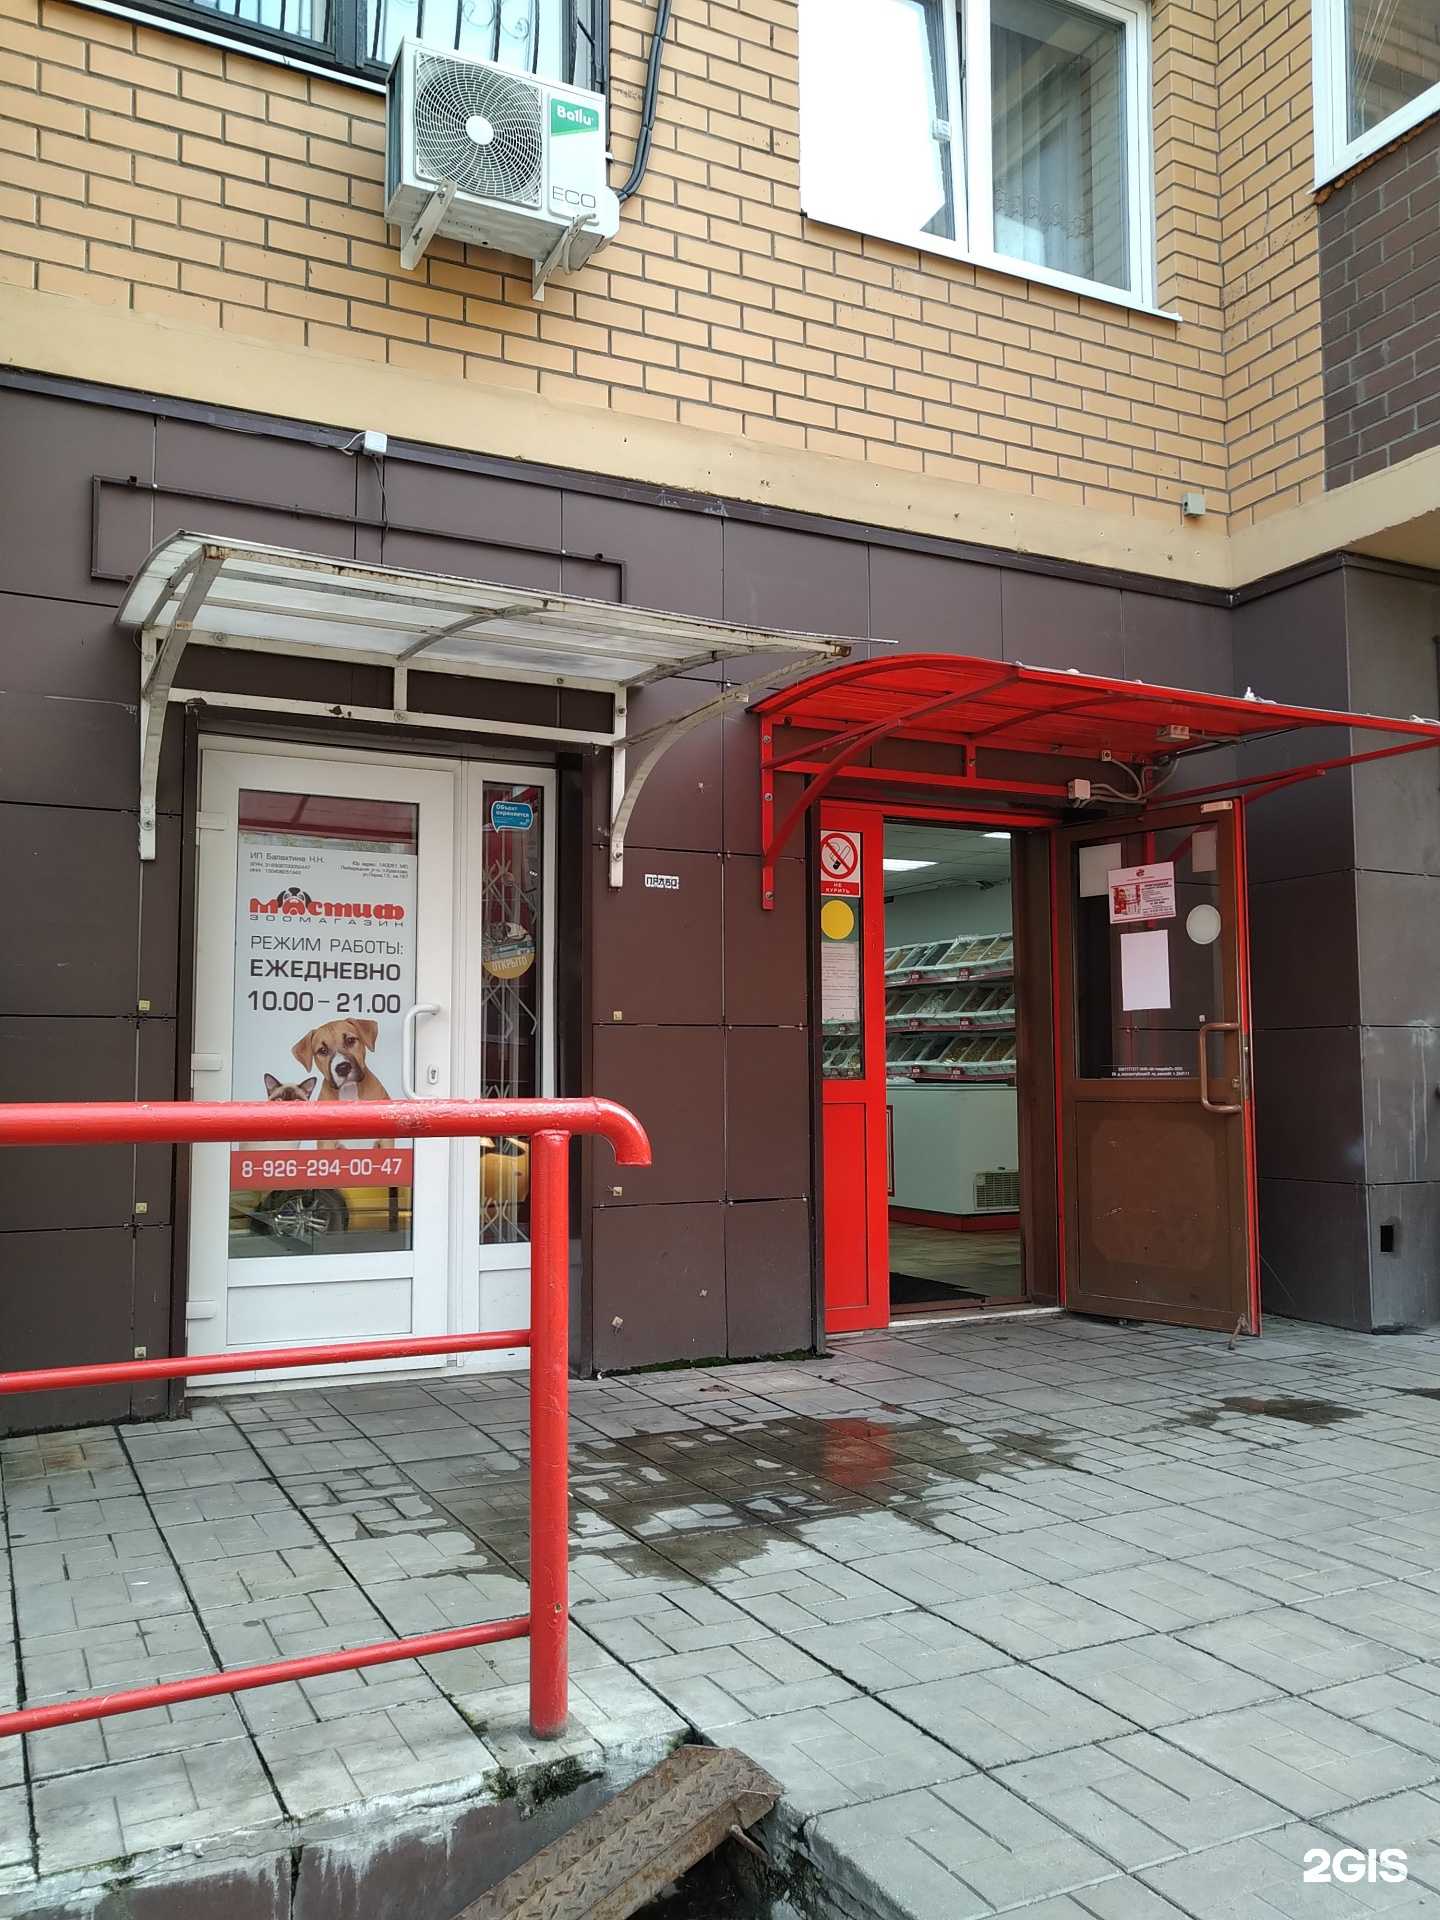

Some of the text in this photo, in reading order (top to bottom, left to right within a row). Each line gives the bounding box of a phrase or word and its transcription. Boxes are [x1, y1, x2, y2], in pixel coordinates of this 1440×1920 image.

[556, 104, 592, 126] Ballu
[552, 185, 596, 209] ECO
[249, 851, 263, 860] ИП
[249, 914, 404, 927] ЗООМАГАЗИН
[250, 935, 404, 955] РЕЖИМ РАБОТЫ:
[250, 958, 401, 982] ЕЖЕДНЕВНО
[491, 955, 529, 972] ОТКРЫТО
[241, 1158, 402, 1178] 8-926-294-00-47
